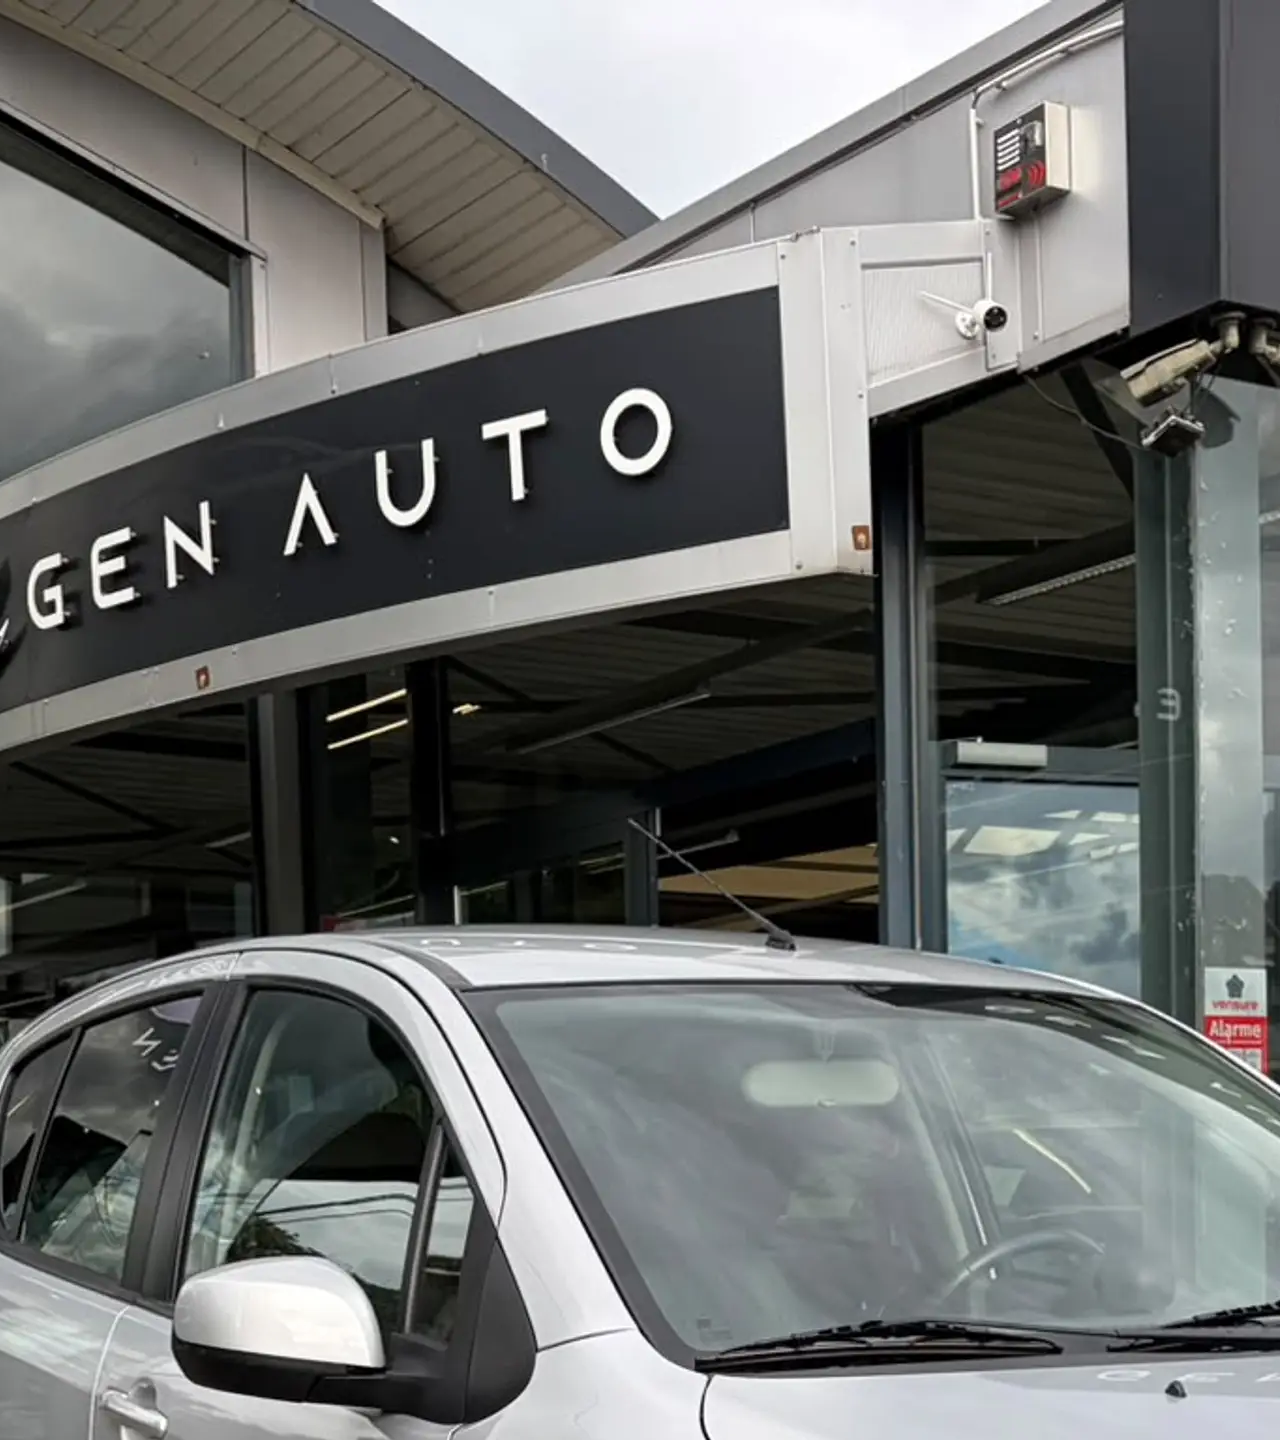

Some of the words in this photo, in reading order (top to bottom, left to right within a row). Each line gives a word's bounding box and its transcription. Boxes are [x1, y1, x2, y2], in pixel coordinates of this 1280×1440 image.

[26, 499, 214, 630] GEN
[282, 387, 673, 557] AUTO
[1209, 1019, 1262, 1038] Alarme
